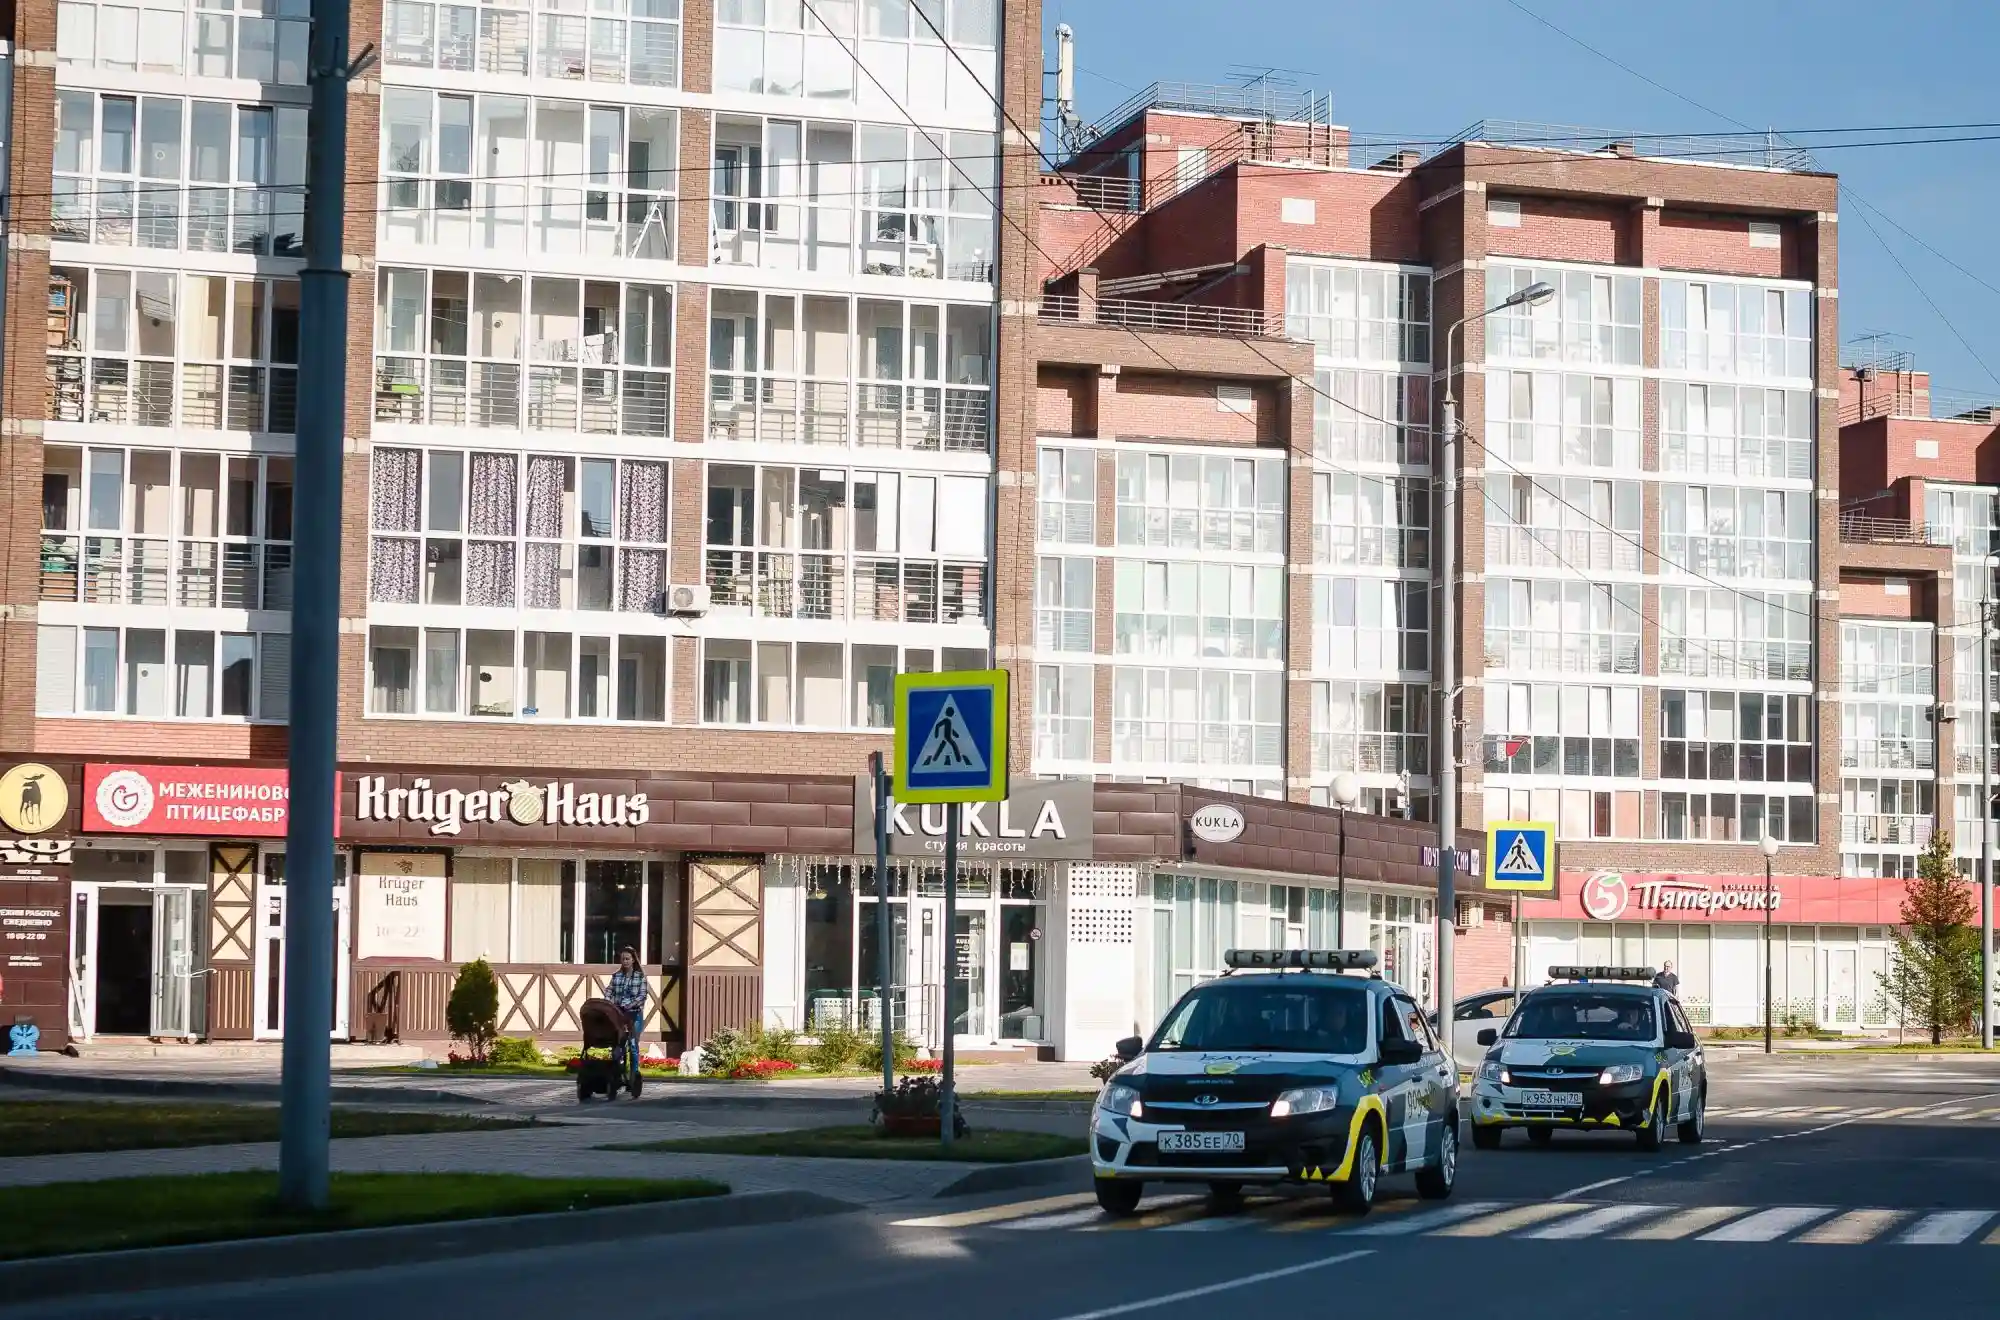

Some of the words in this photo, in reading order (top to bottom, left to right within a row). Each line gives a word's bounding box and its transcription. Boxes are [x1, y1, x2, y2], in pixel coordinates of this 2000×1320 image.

[159, 782, 289, 800] МЕЖЕНИНОВ
[165, 804, 286, 823] ПТИЦЕФАБР
[357, 775, 510, 835] Krüger
[547, 782, 649, 826] Haus
[886, 796, 1067, 839] KUKLA
[1195, 816, 1239, 828] KUKLA
[924, 840, 968, 853] стуия
[974, 841, 1026, 853] красоты
[1423, 846, 1440, 868] ПОЧТ
[386, 894, 418, 907] Haus
[1309, 952, 1360, 965] ГБР
